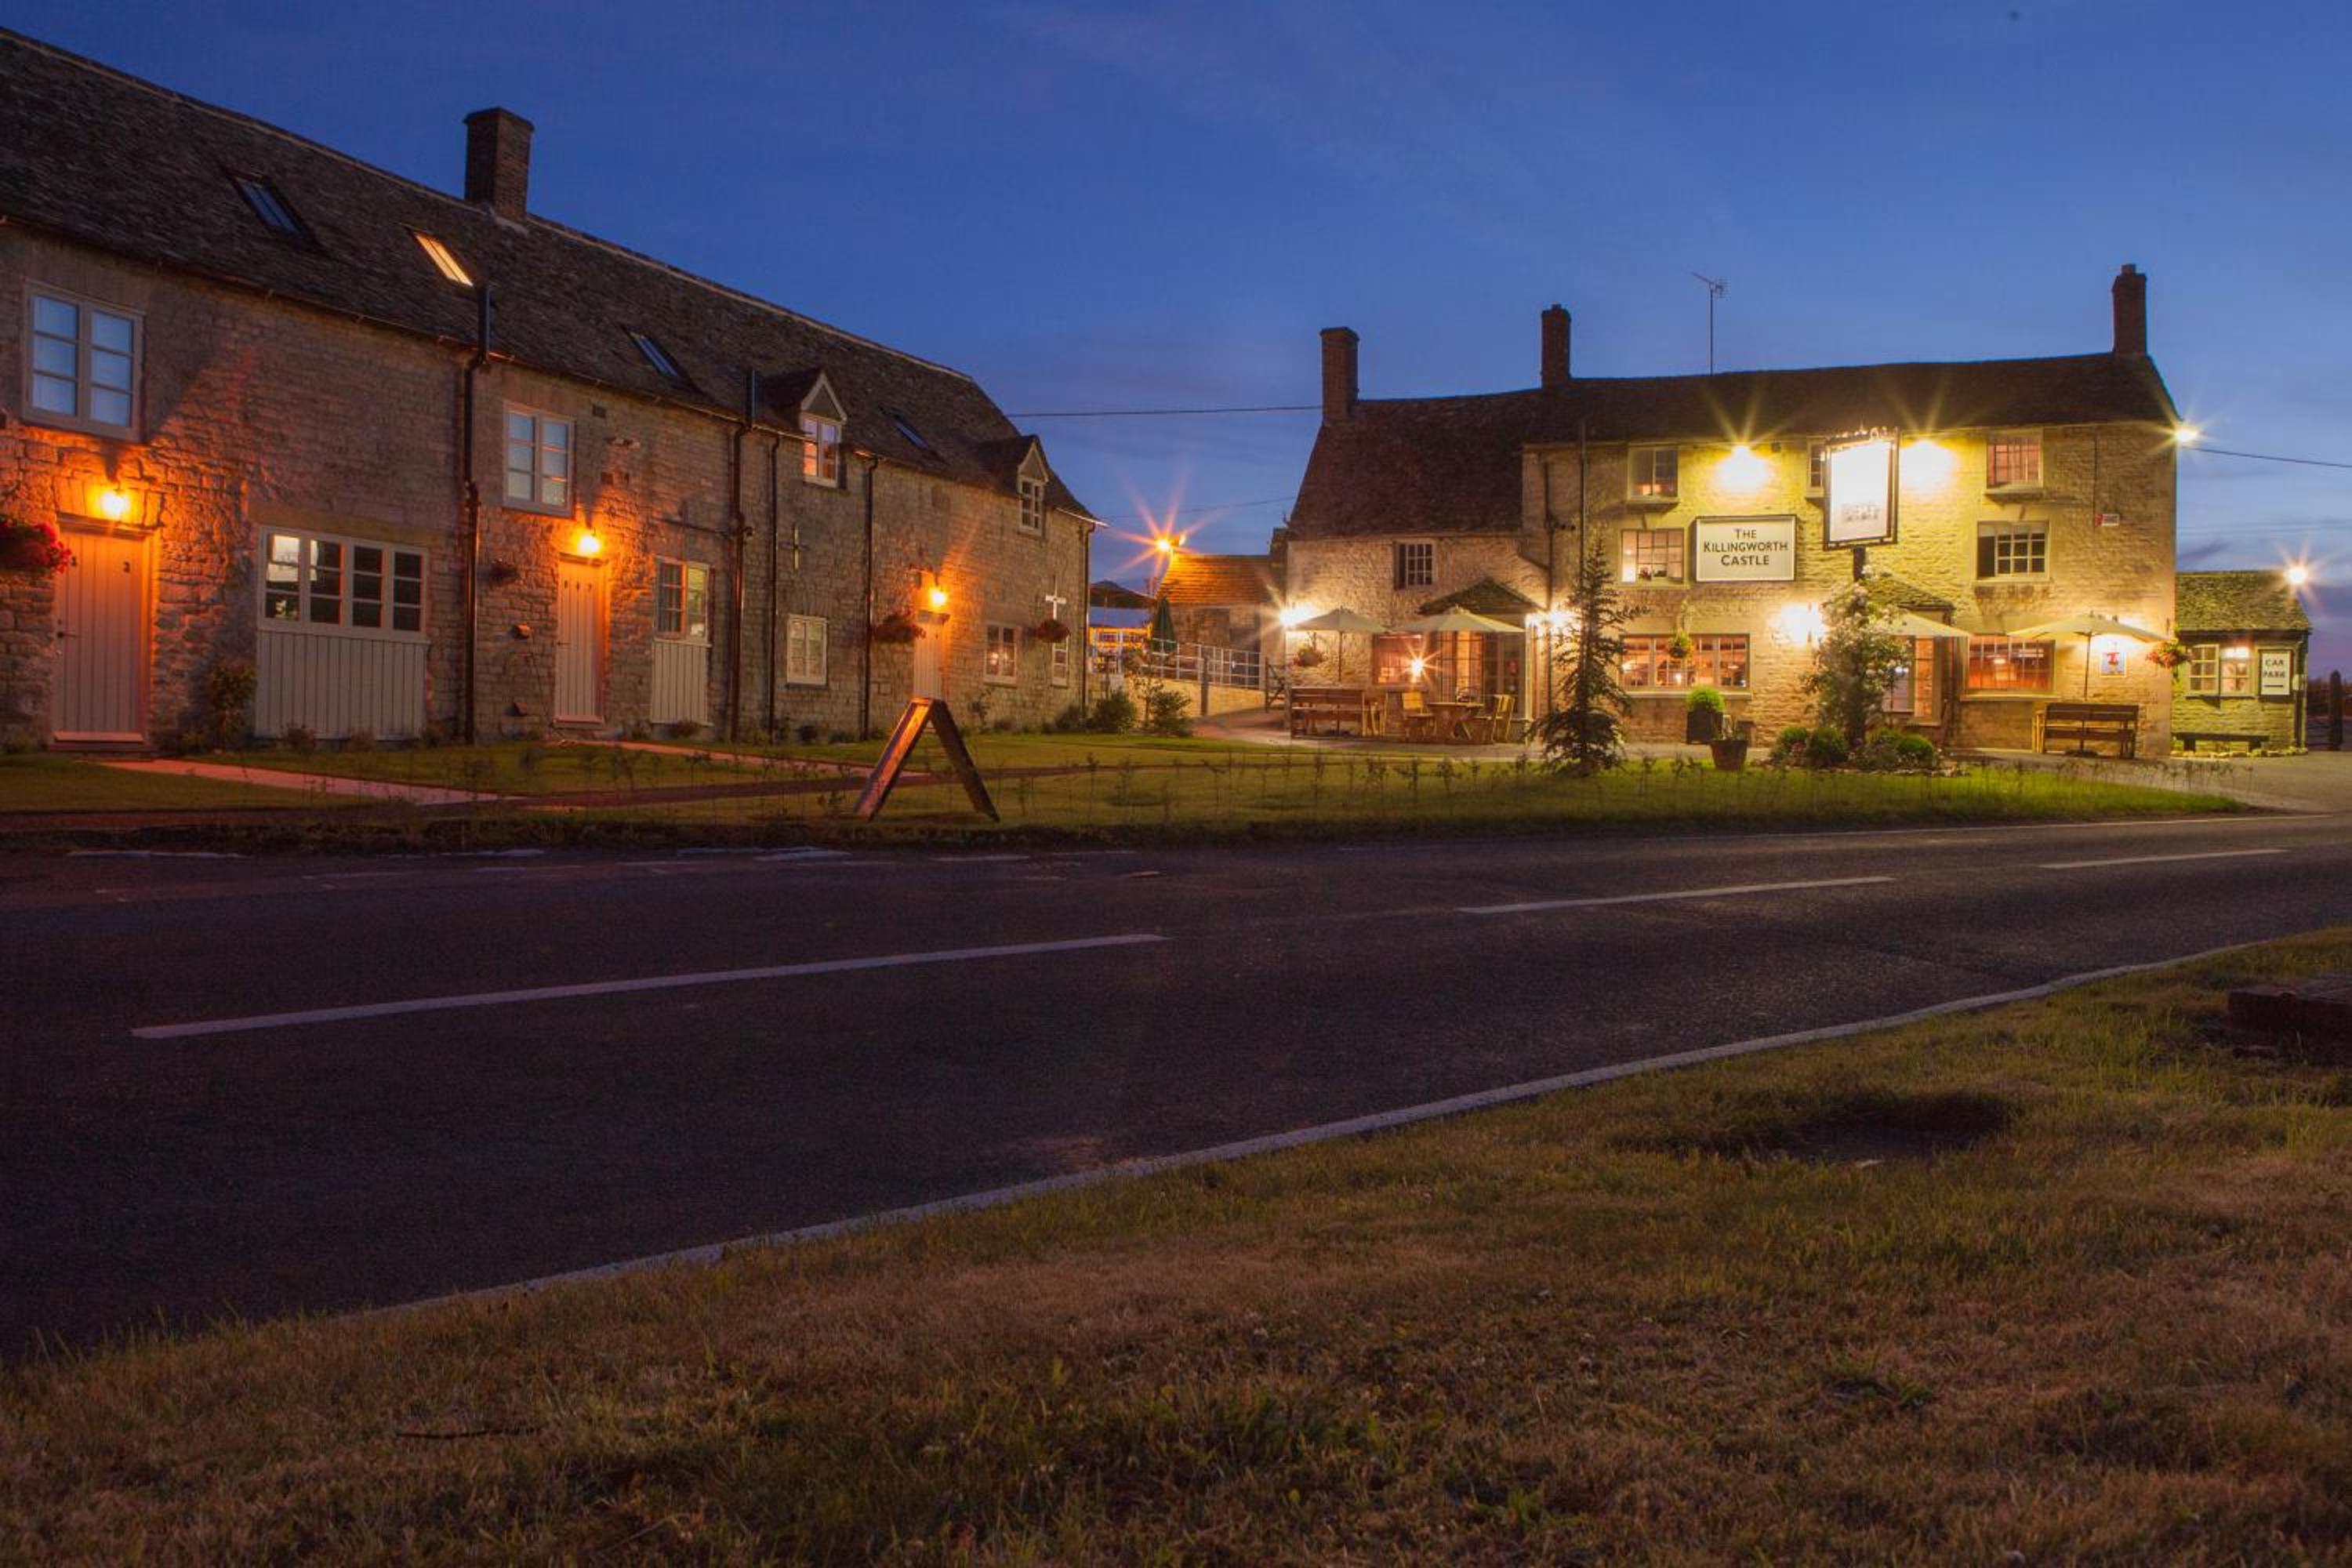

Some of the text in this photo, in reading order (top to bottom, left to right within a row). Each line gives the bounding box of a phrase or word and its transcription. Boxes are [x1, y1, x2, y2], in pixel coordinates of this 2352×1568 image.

[1733, 528, 1757, 539] THE
[1703, 541, 1788, 553] KILLINGWORTH
[1720, 554, 1769, 565] CASTLE
